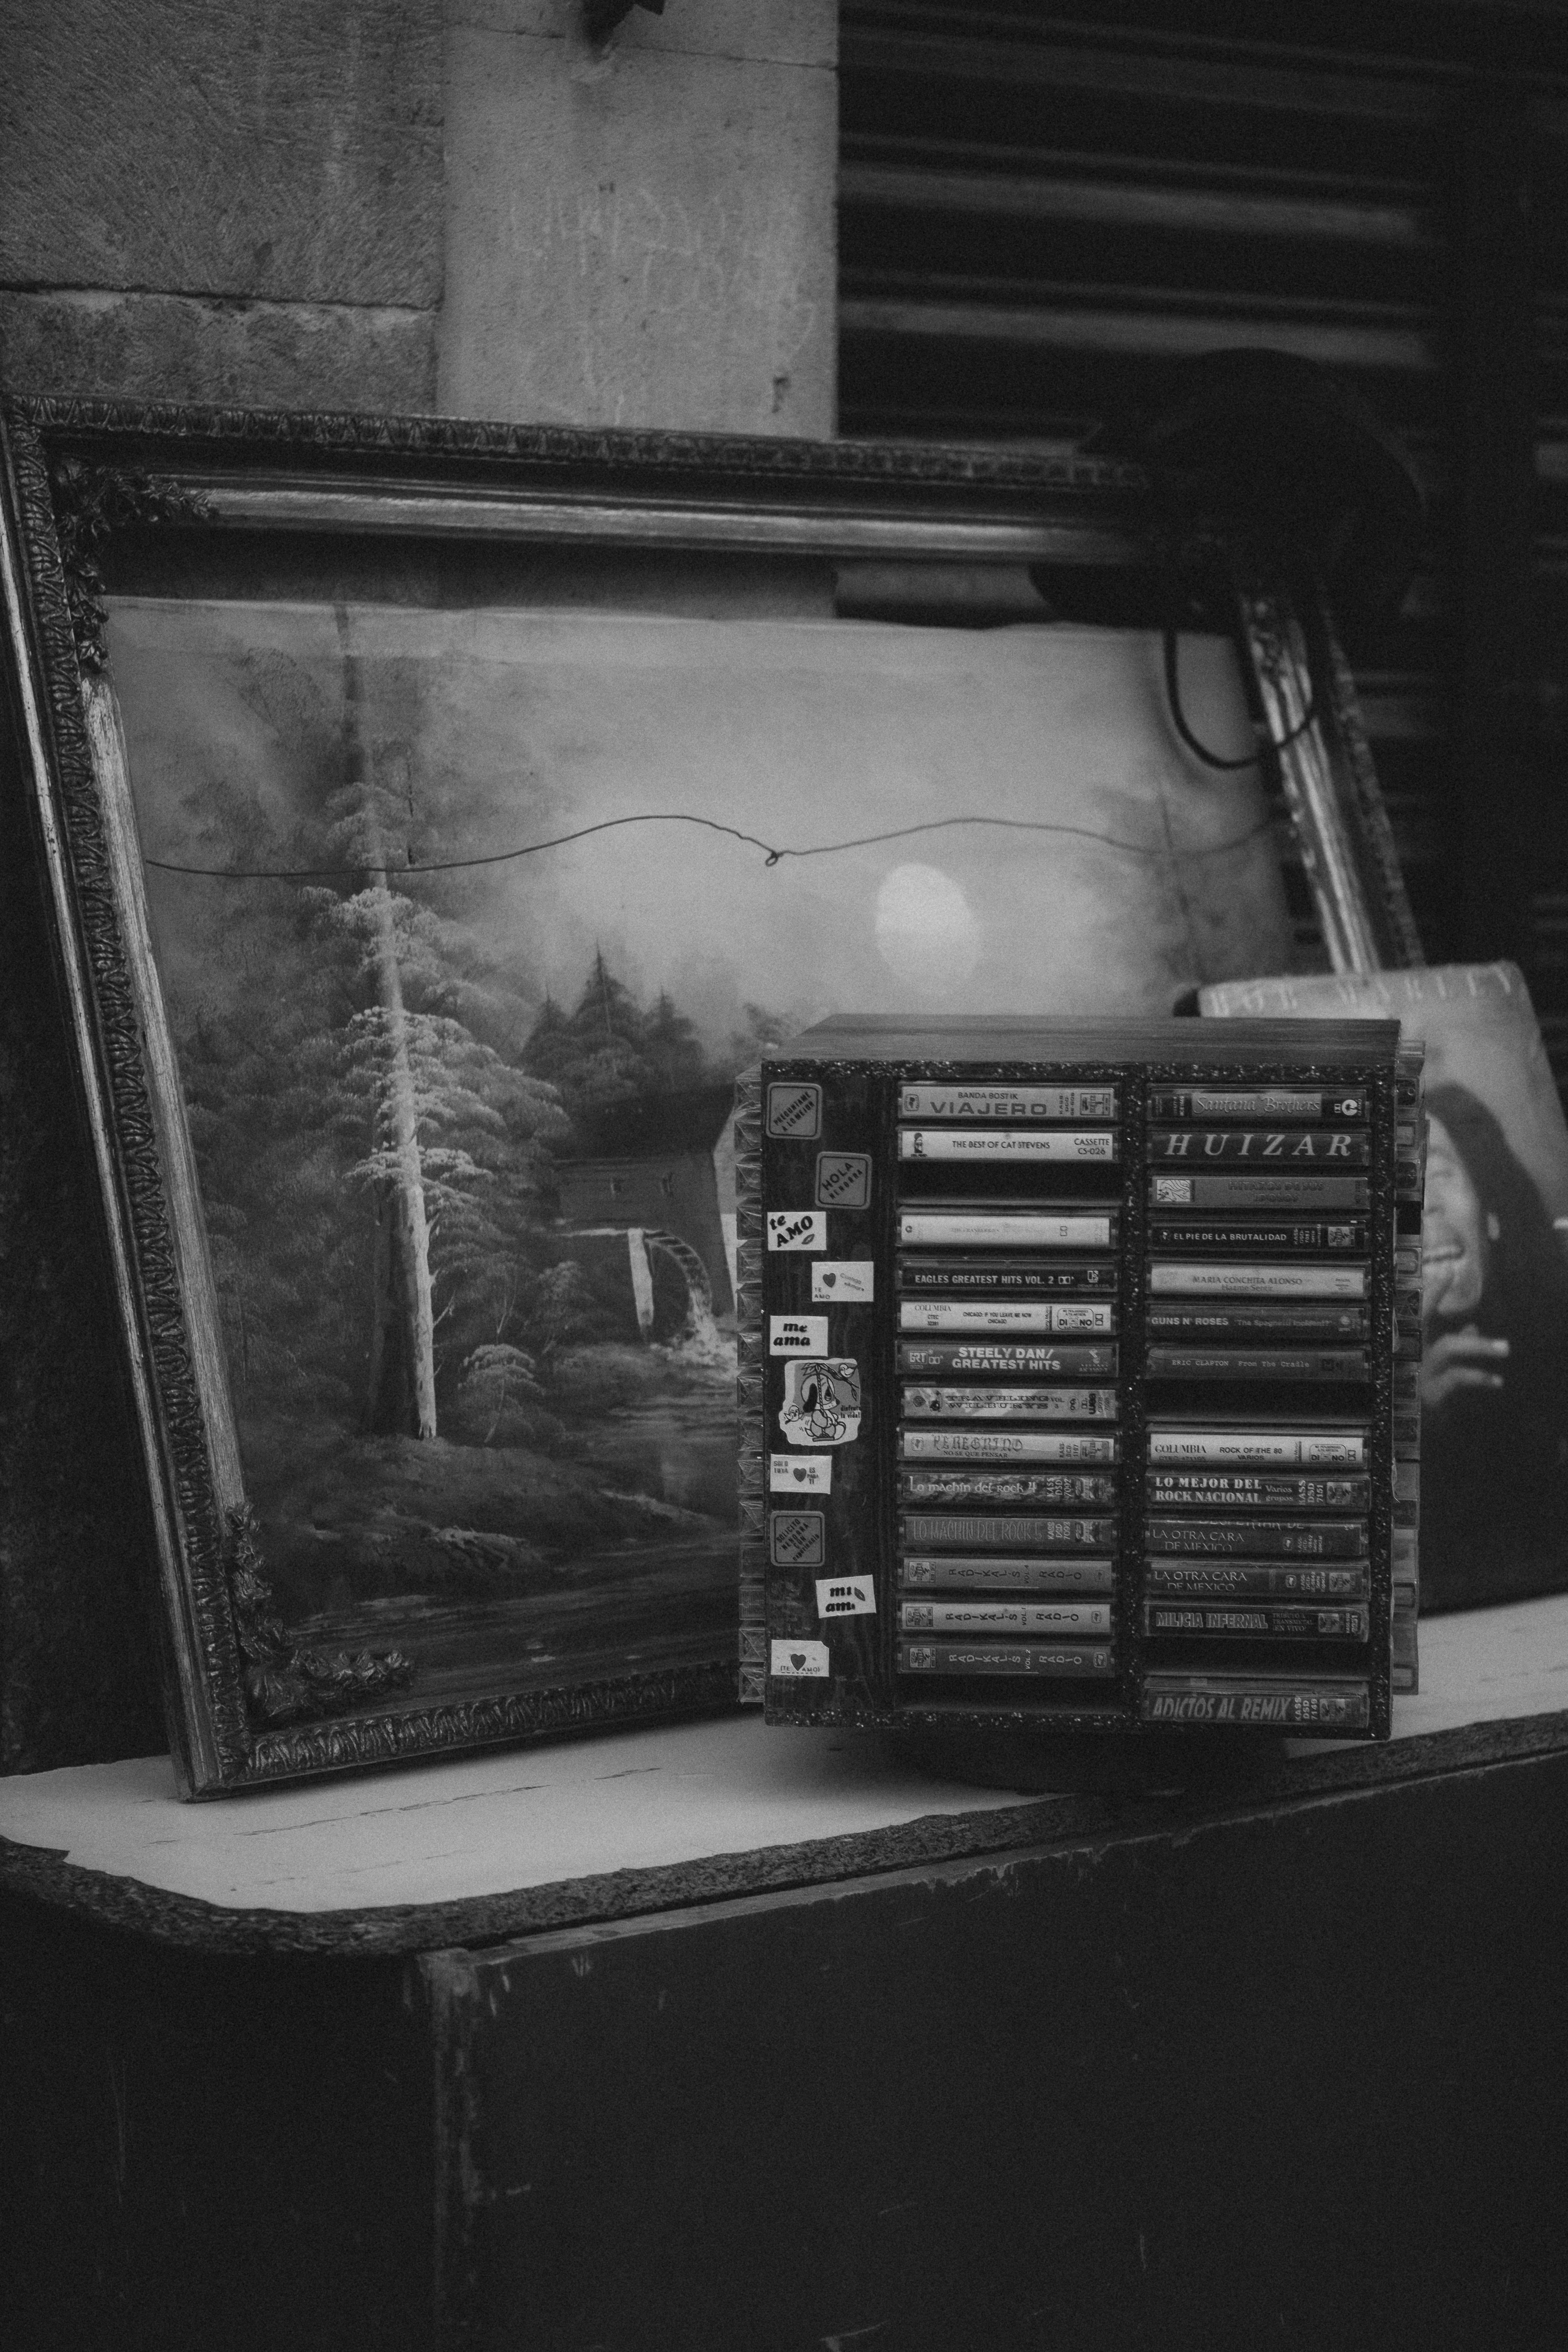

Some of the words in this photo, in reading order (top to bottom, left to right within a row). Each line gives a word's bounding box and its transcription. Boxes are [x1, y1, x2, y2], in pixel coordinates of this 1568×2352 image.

[773, 1092, 811, 1126] PREGUNTAME
[930, 1102, 1047, 1115] VIAJERO
[1193, 1097, 1256, 1114] Santana
[1257, 1096, 1320, 1116] Brothers
[786, 1118, 796, 1127] LO
[795, 1101, 815, 1120] MEJOR
[1164, 1134, 1351, 1156] HUIZAR
[822, 1162, 853, 1191] HOLA
[829, 1169, 863, 1199] NENORRA
[1285, 1182, 1300, 1191] DE
[770, 1215, 786, 1230] te
[777, 1216, 813, 1248] AMO
[915, 1275, 950, 1284] EAGLES
[952, 1275, 997, 1284] GREATEST
[1002, 1276, 1022, 1284] HITS
[1025, 1276, 1044, 1284] VOL.
[1192, 1276, 1221, 1284] MARIA
[1223, 1276, 1265, 1285] CONCHITA
[1267, 1277, 1302, 1285] ALONSO
[783, 1323, 807, 1332] me
[773, 1336, 811, 1346] ama
[959, 1347, 1012, 1357] STEELY
[1016, 1348, 1054, 1359] DAN/
[952, 1359, 1025, 1369] GREATEST
[1029, 1360, 1061, 1371] HITS
[933, 1434, 1023, 1452] PEREGRINO
[1155, 1445, 1207, 1454] COLUMBIA
[909, 1476, 924, 1491] Lo
[975, 1482, 993, 1492] del
[1028, 1482, 1037, 1493] 4
[1156, 1477, 1174, 1487] LO
[1178, 1477, 1229, 1488] MEJOR
[1234, 1478, 1262, 1489] DEL
[1156, 1491, 1192, 1501] ROCK
[1195, 1491, 1261, 1503] NACIONAL
[776, 1518, 800, 1543] SOLICITO
[782, 1523, 809, 1550] NENORRA
[913, 1520, 927, 1541] LO
[931, 1520, 973, 1541] MACHIN
[977, 1520, 998, 1541] DEL
[1002, 1521, 1031, 1541] ROCK
[1153, 1530, 1168, 1538] LA
[1171, 1531, 1205, 1540] OTRA
[1210, 1531, 1245, 1542] CARA
[793, 1536, 807, 1549] CON
[1165, 1542, 1180, 1550] DE
[1184, 1542, 1232, 1551] MEXICO
[1039, 1570, 1082, 1580] RADIO
[1155, 1572, 1169, 1580] LA
[1174, 1572, 1208, 1581] OTRA
[1212, 1572, 1247, 1582] CARA
[829, 1586, 852, 1597] mi
[1187, 1583, 1235, 1591] MEXICO
[1036, 1613, 1079, 1622] RADIO
[1156, 1612, 1203, 1627] MILICIA
[1206, 1613, 1268, 1629] INFERNAL
[1039, 1655, 1082, 1665] RADIO
[1153, 1697, 1215, 1718] ADICTOS
[1216, 1698, 1235, 1719] AL
[1240, 1698, 1292, 1720] REMIX
